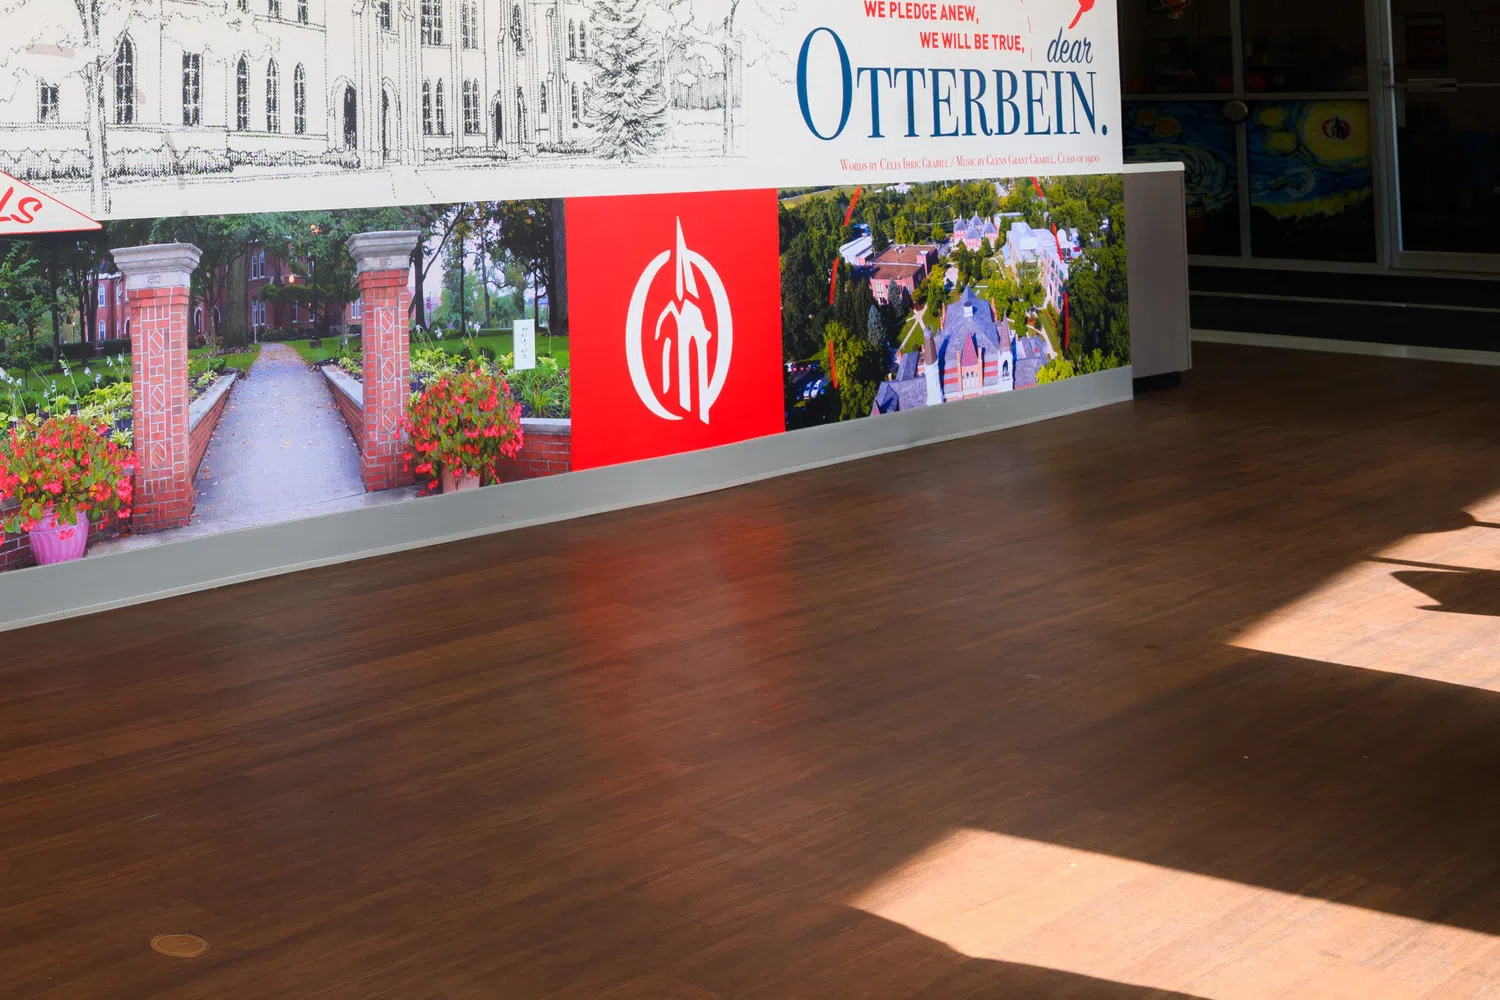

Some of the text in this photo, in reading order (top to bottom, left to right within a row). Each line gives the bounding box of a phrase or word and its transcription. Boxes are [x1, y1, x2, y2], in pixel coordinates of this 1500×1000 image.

[864, 0, 979, 25] WE PLEDGE ANEW,
[919, 31, 1025, 53] WE WILL BE TRUE,
[1047, 26, 1093, 64] dear
[796, 27, 1108, 141] OTTERBEIN.
